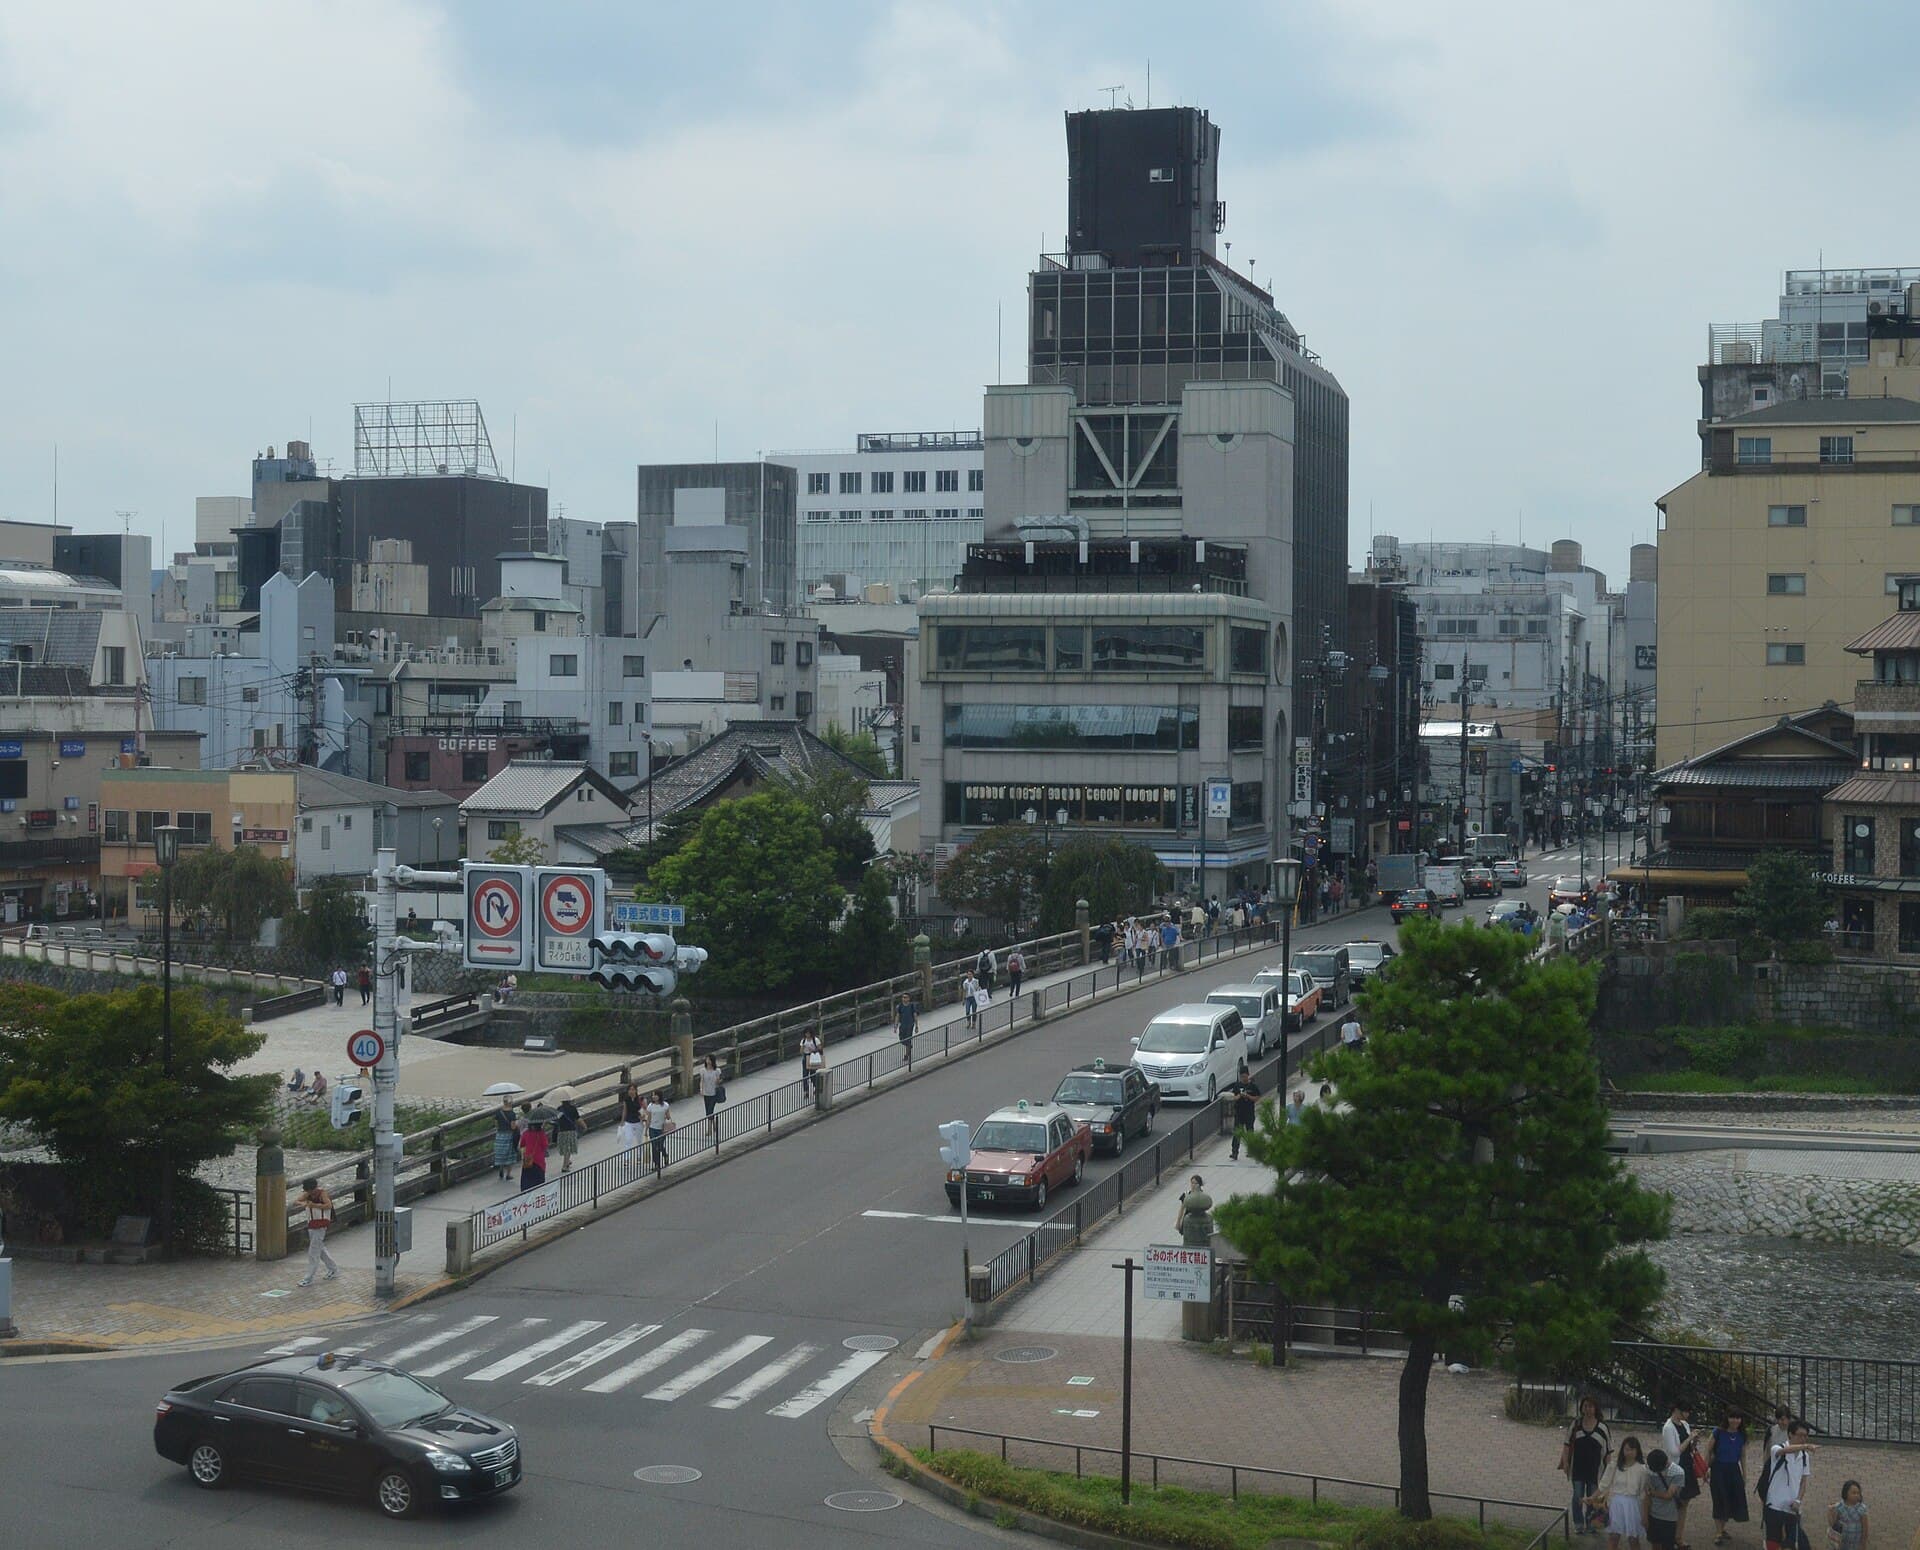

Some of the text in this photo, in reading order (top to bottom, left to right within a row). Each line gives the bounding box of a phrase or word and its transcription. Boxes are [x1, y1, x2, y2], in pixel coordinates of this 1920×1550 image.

[438, 738, 497, 751] COFFEE
[1822, 872, 1855, 885] COFFEE
[618, 905, 681, 922] 時差式信号機
[355, 1039, 376, 1057] 40
[1146, 1248, 1208, 1265] ごみのポイ捨て禁止
